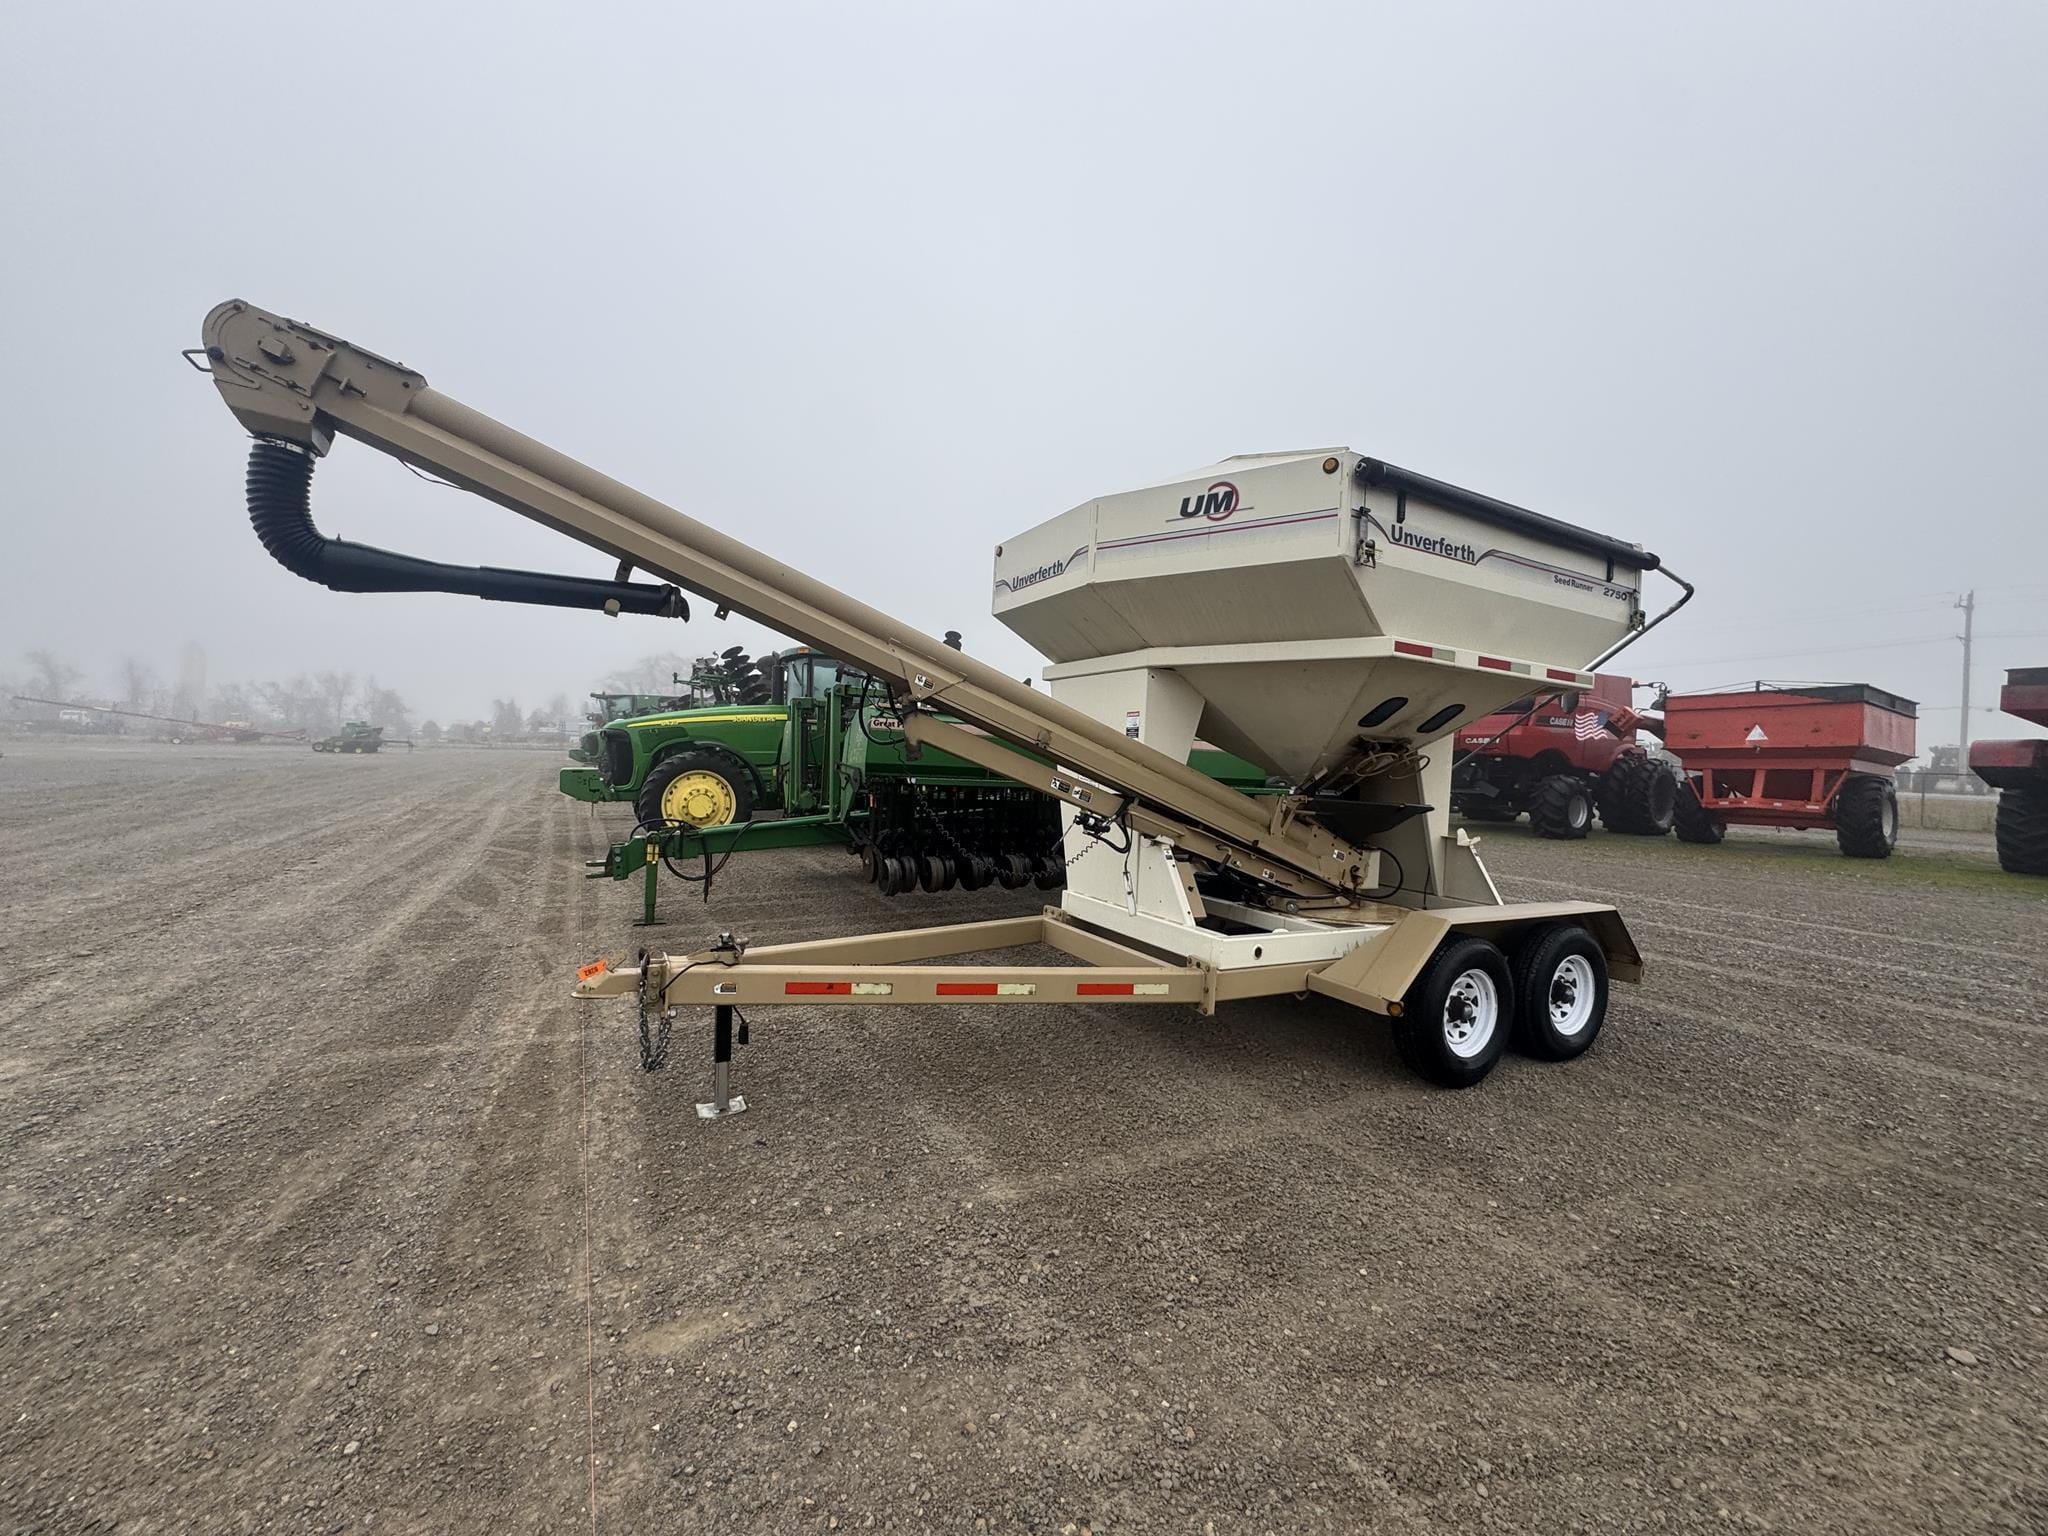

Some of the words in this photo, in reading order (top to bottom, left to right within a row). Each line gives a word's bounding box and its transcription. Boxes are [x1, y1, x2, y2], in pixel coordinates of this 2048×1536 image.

[1180, 490, 1234, 518] UM
[1391, 524, 1475, 562] Unverferth
[1012, 560, 1063, 589] Unverferth
[1553, 575, 1570, 586] Seed
[1571, 579, 1594, 592] Runner
[1603, 587, 1628, 601] 2750
[873, 719, 896, 728] Great
[1549, 717, 1567, 726] CASE
